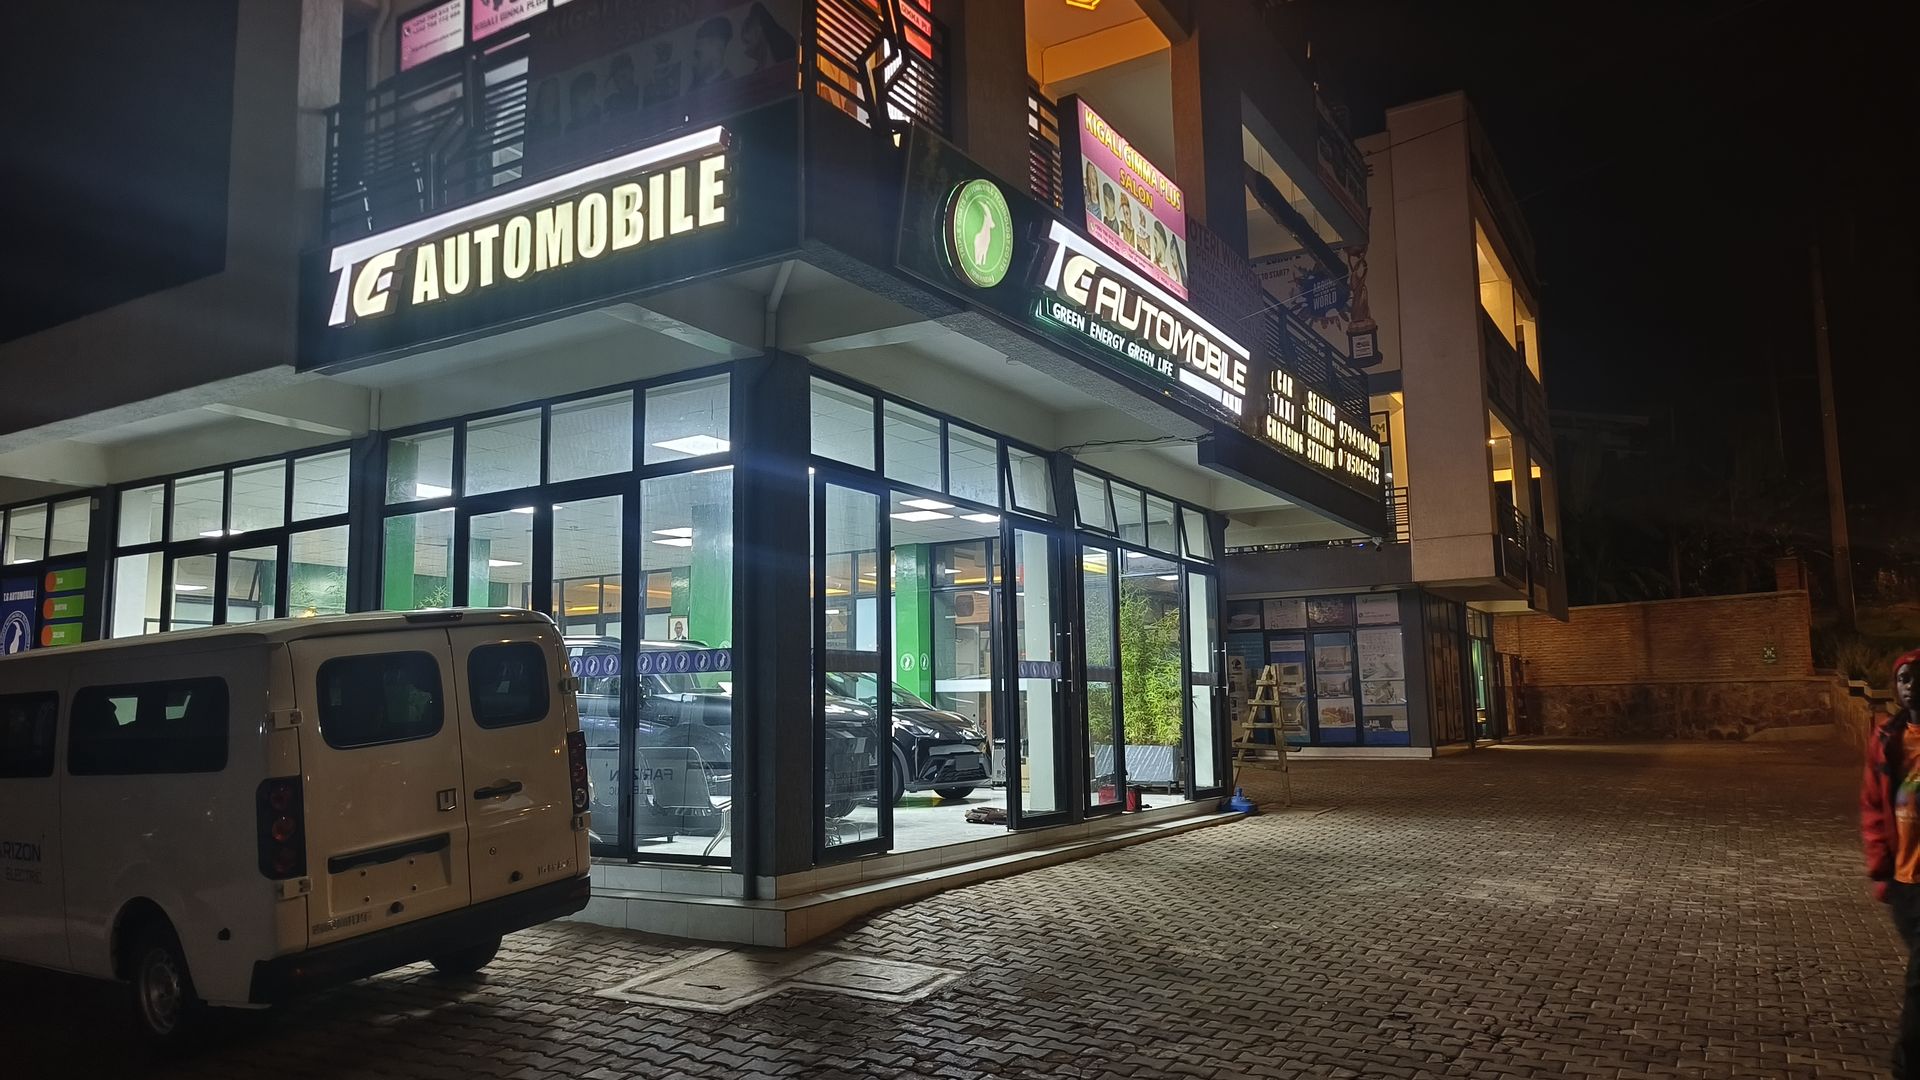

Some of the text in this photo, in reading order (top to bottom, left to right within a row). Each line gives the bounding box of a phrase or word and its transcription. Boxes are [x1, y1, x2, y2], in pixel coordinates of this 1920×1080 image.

[1083, 106, 1182, 212] KIGALI GIMMA PLUS
[1119, 168, 1154, 210] SALON
[412, 154, 726, 306] AUTOMOBILE
[1313, 291, 1337, 311] WORLD
[1052, 302, 1174, 378] GREEN ENERGY GREEN LIFE
[1095, 277, 1248, 396] AUTOMOBILE
[1277, 369, 1293, 398] CAR
[1273, 392, 1295, 425] TAXI
[1307, 390, 1336, 425] SELLING
[1266, 414, 1303, 455] CHARGING
[1307, 414, 1335, 449] RENTING
[1306, 438, 1335, 471] STATION
